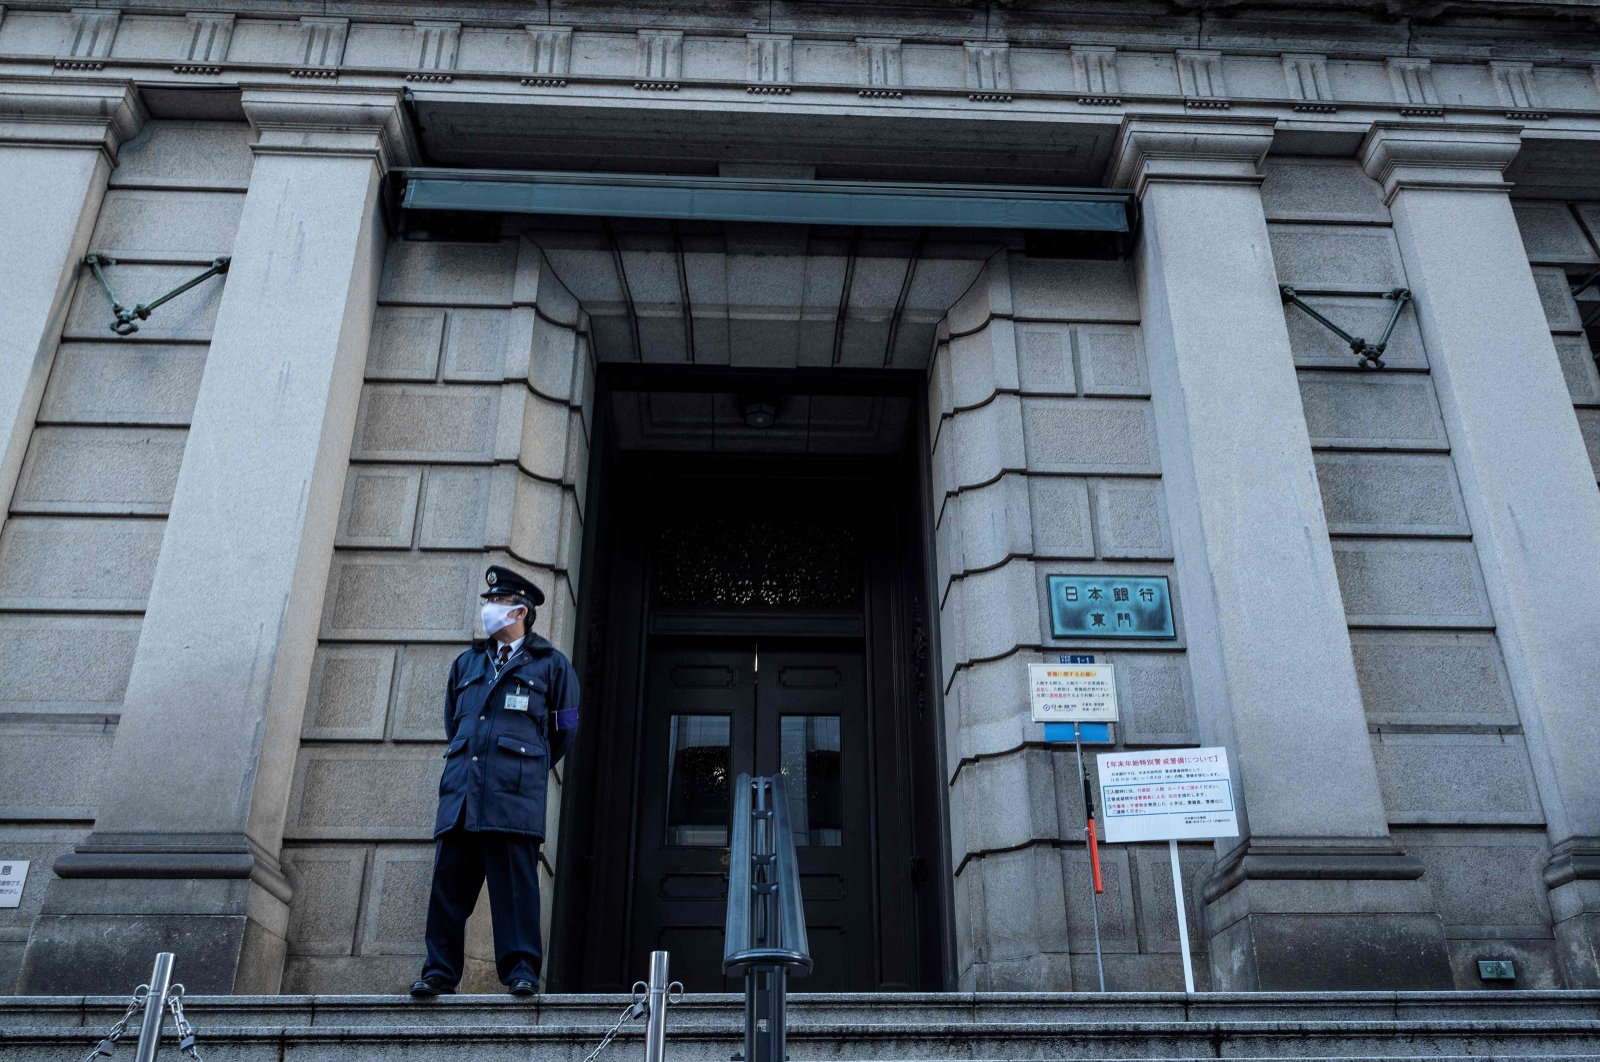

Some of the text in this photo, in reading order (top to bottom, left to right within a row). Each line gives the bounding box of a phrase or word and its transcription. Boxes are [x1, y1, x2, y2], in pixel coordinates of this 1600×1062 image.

[1065, 586, 1154, 602] 日本銀行
[1091, 613, 1132, 628] 東門
